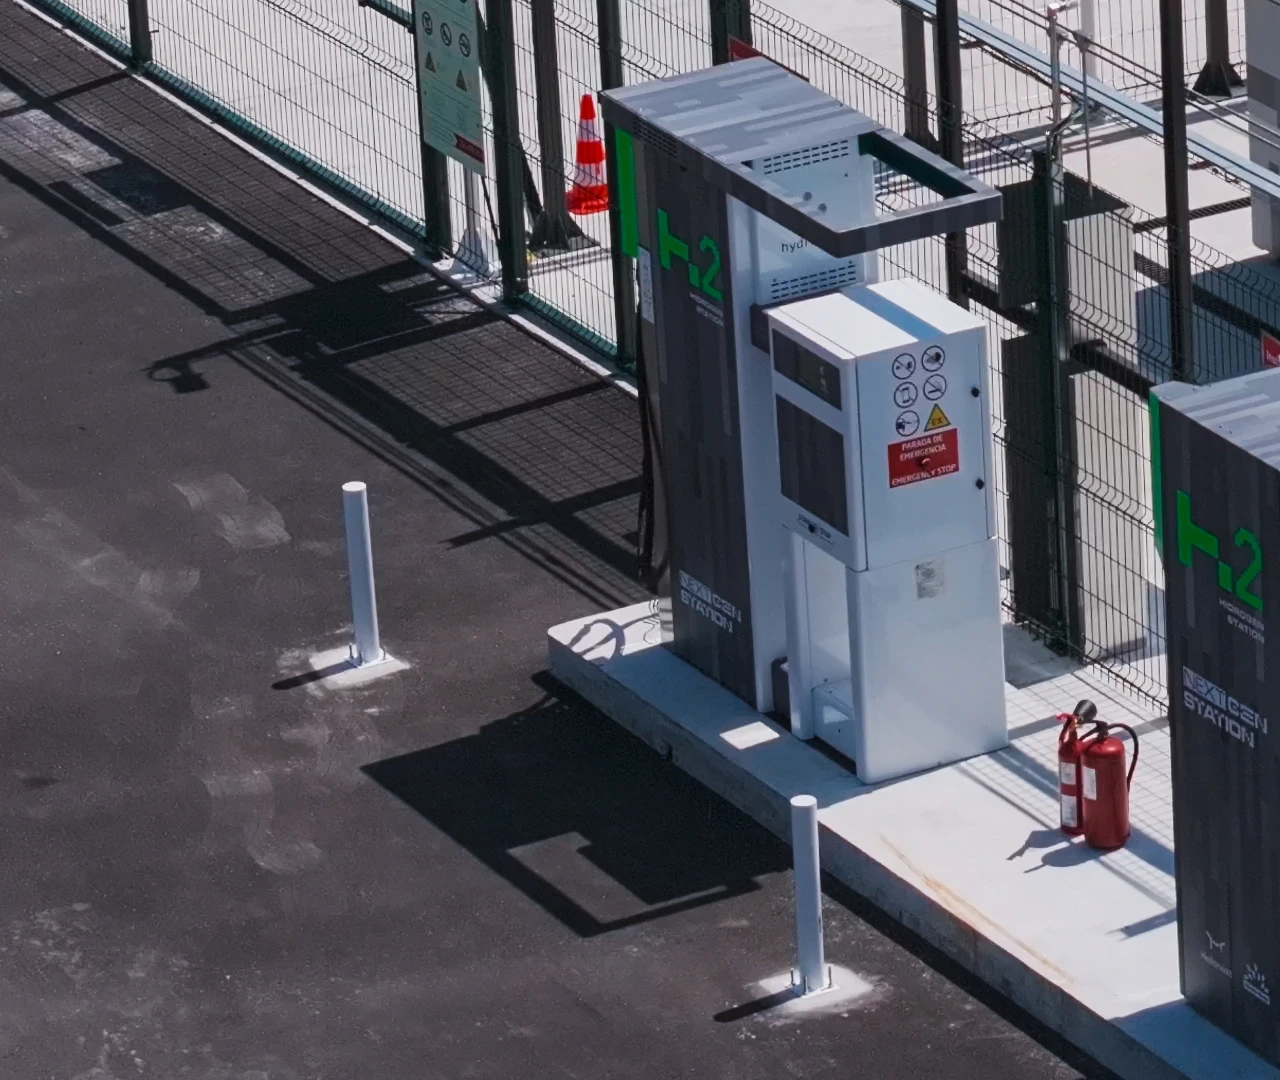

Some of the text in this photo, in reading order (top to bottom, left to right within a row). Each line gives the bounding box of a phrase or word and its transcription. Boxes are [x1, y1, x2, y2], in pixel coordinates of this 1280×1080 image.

[902, 434, 943, 451] PARADA DE
[937, 463, 956, 474] STOP
[680, 589, 732, 633] STATION
[1227, 614, 1265, 644] STATION
[1183, 665, 1268, 735] NEXT GEN
[1183, 690, 1255, 748] STATION
